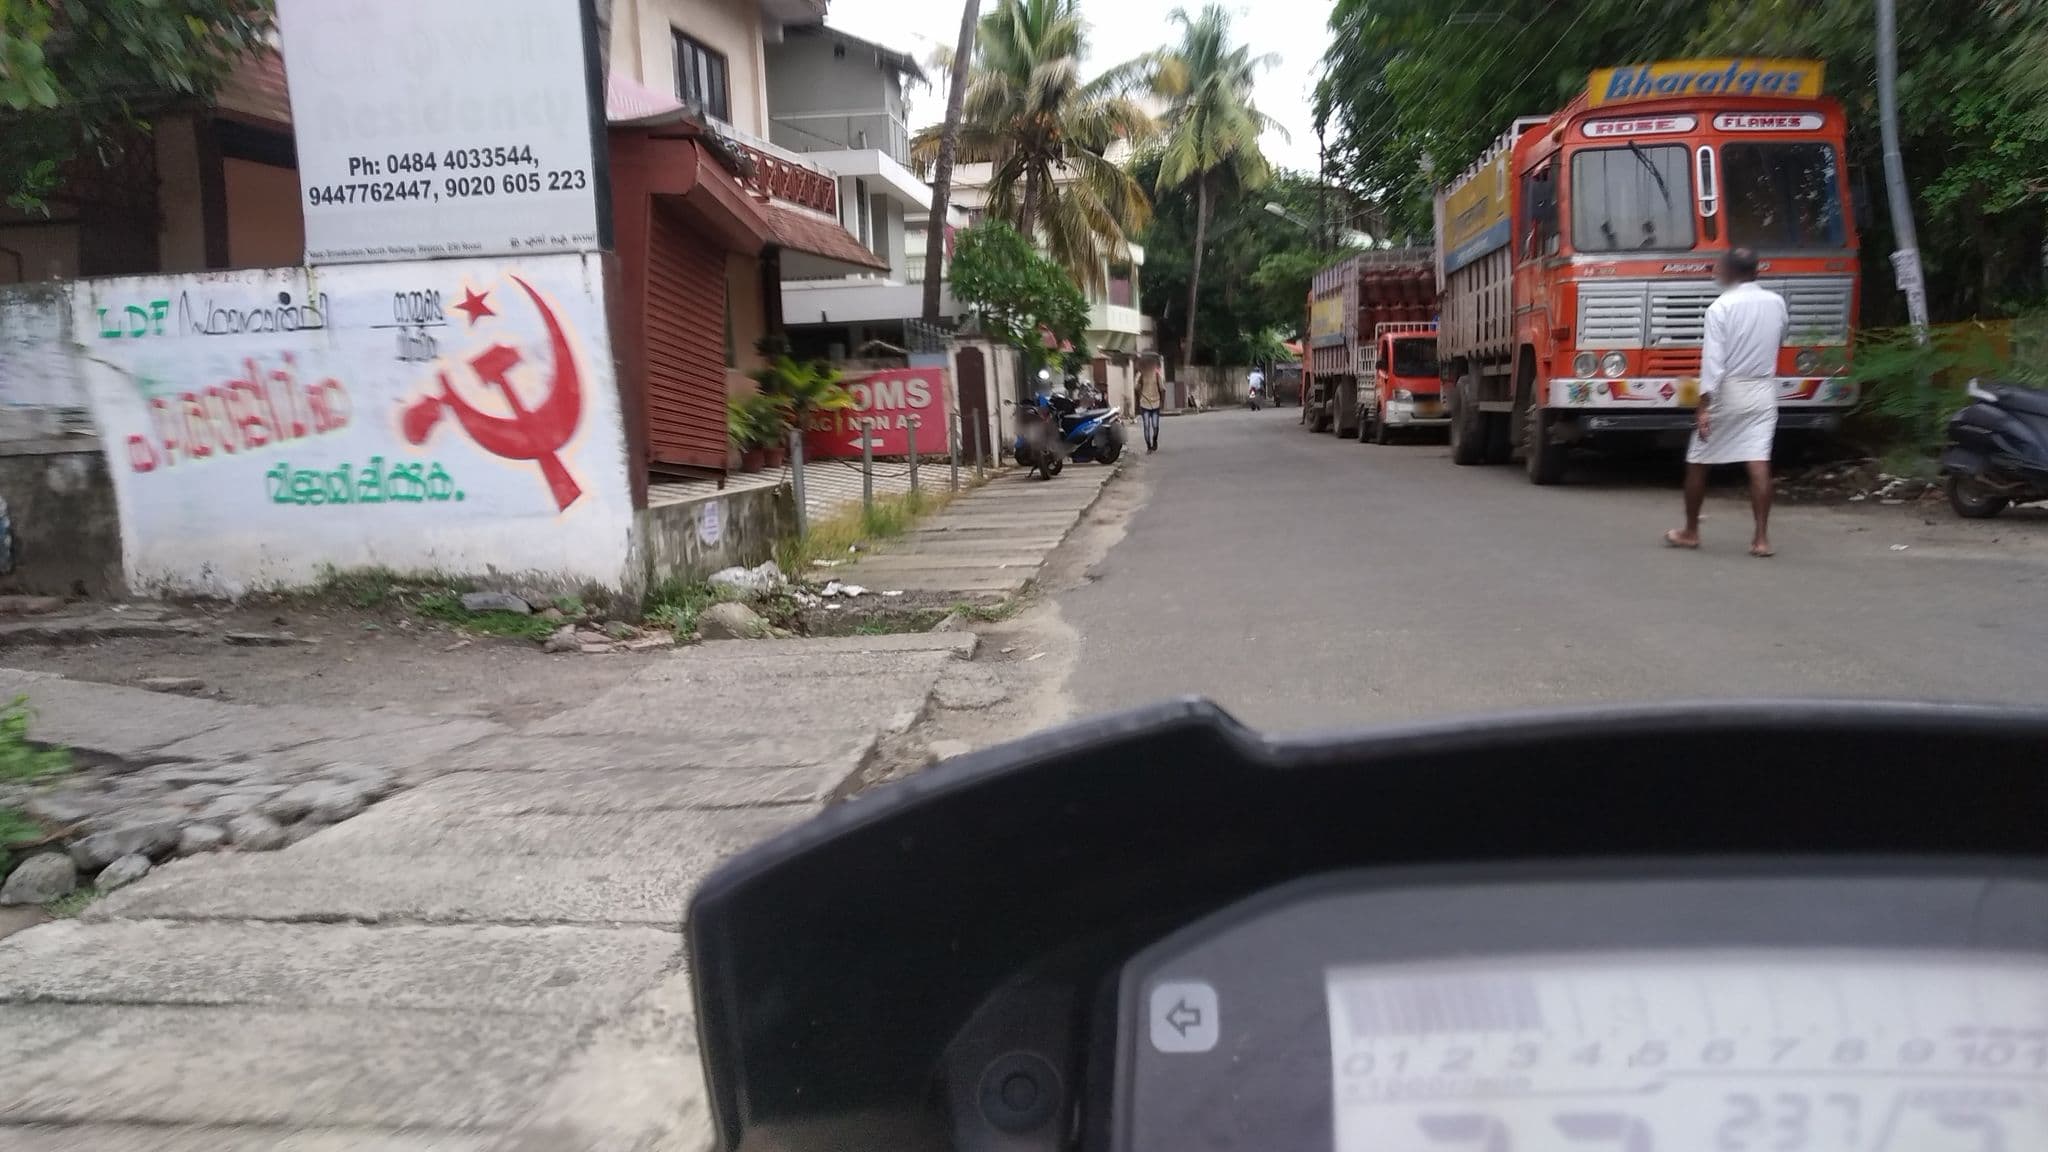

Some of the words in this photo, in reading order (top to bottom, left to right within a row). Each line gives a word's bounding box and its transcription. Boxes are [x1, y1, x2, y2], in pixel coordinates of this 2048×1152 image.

[1604, 61, 1806, 99] Bharatgas
[1595, 119, 1678, 135] ROSE
[1723, 116, 1801, 129] FLAMES
[349, 156, 380, 176] Ph:
[387, 151, 437, 174] 0484
[443, 145, 540, 169] 4033544,
[308, 180, 438, 206] 9447762447,
[445, 175, 496, 198] 9020
[502, 173, 541, 194] 605
[548, 170, 587, 191] 223
[98, 300, 170, 338] LDF
[848, 415, 890, 431] NON
